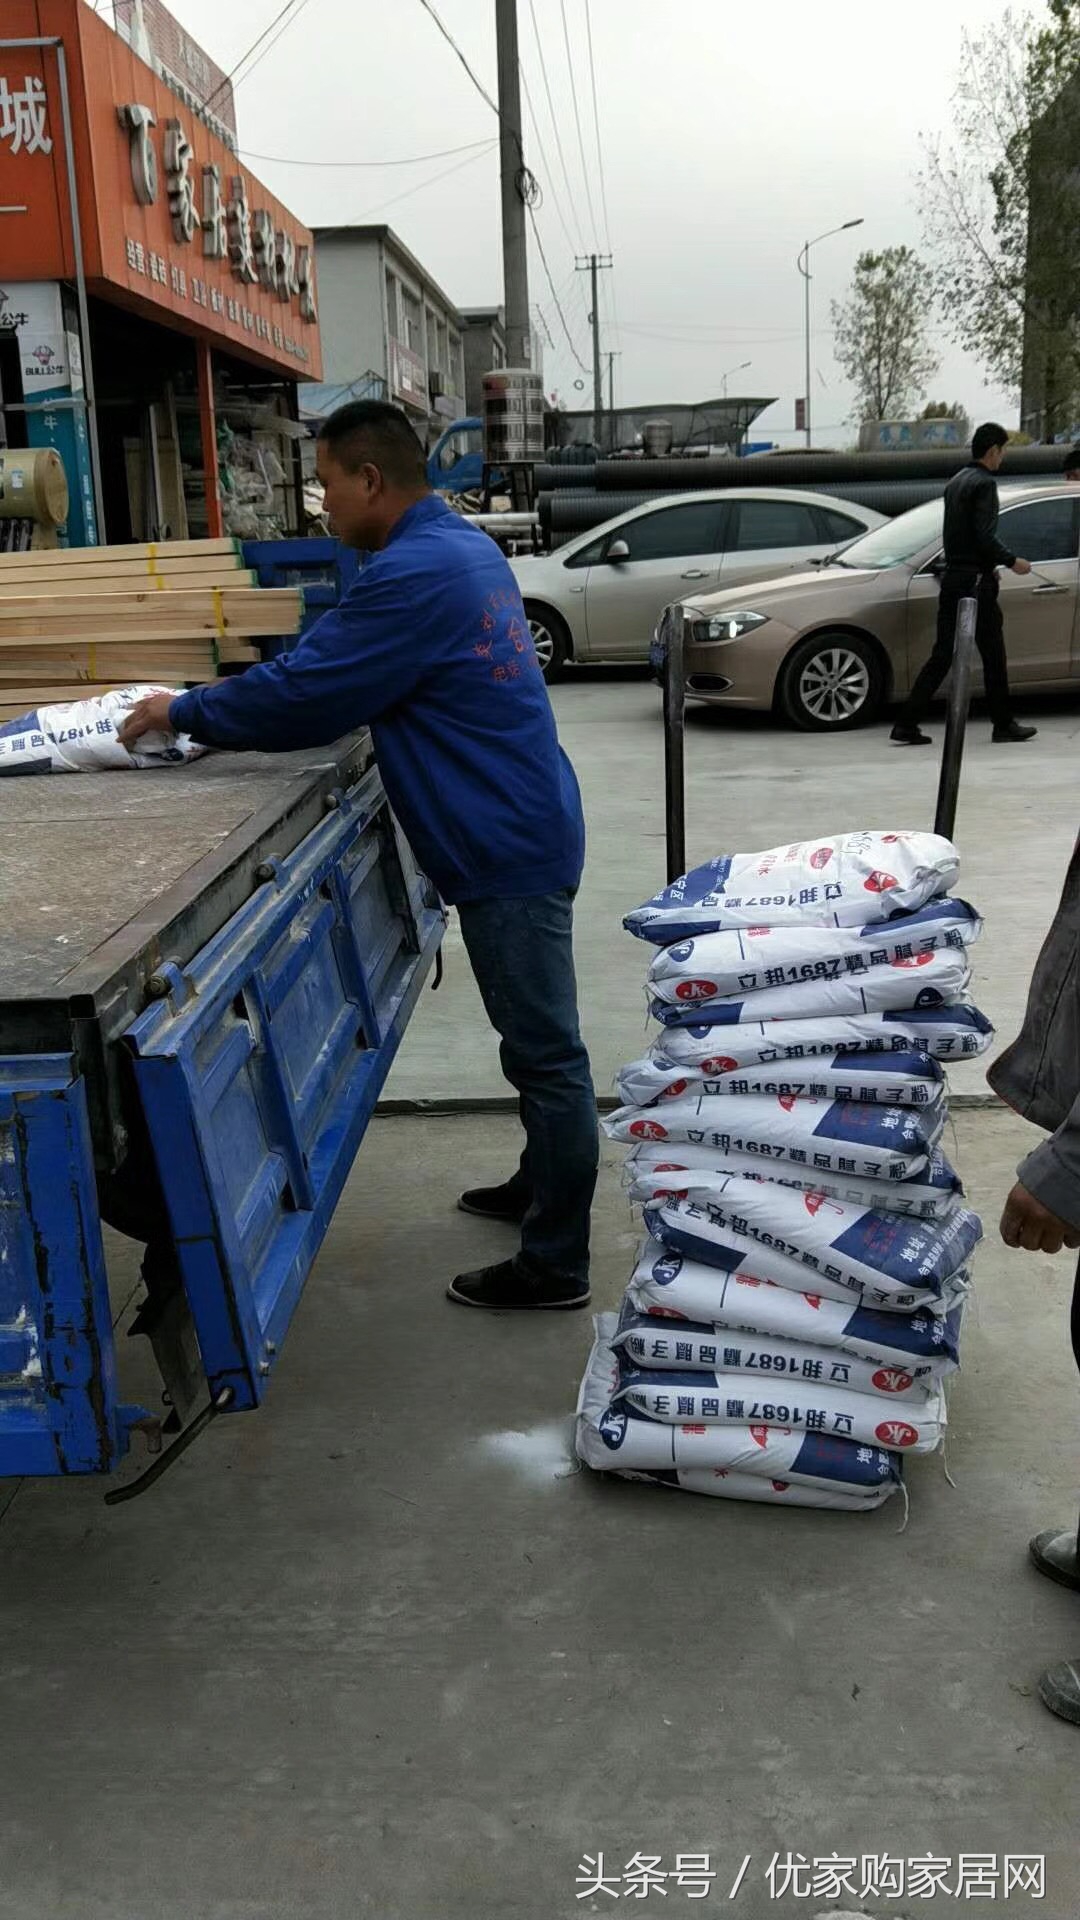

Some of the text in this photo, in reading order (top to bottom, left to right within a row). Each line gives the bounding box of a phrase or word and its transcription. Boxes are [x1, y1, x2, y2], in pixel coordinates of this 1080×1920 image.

[0, 76, 52, 155] 城
[737, 928, 964, 991] 立邦1687精品腻子粉
[683, 982, 709, 999] JK
[687, 1129, 908, 1180] 立邦1687精品腻子粉
[630, 1336, 852, 1384] 立邦1687精品腻子粉
